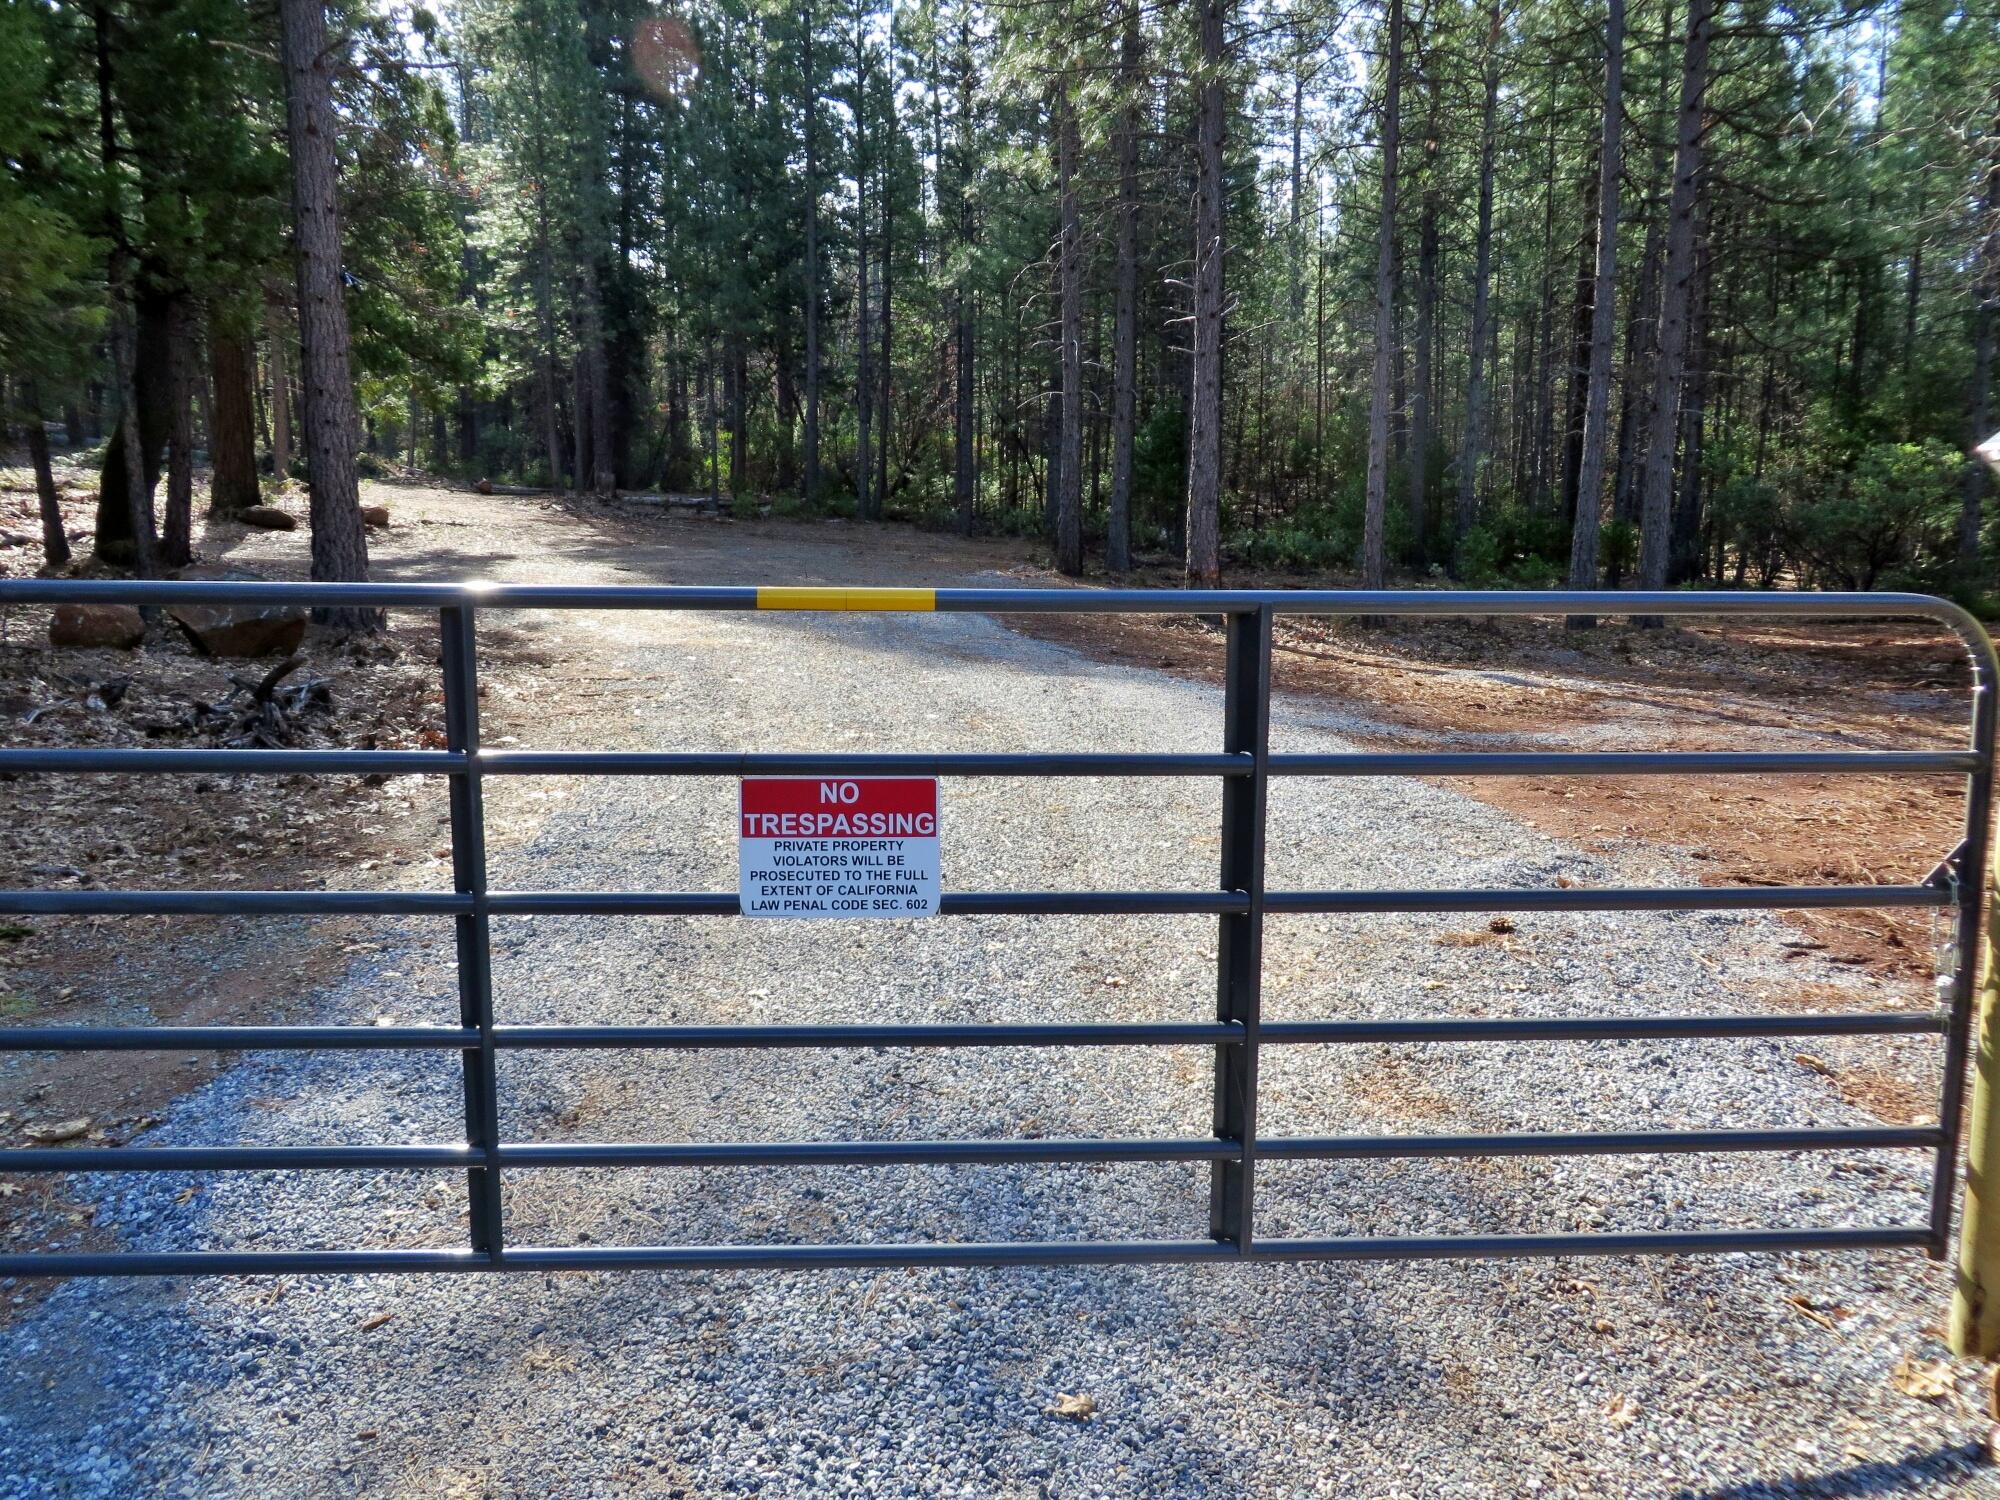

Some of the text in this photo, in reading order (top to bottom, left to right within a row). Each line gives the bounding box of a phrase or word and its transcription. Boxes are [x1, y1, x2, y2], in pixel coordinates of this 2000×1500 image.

[820, 782, 859, 804] NO
[744, 813, 934, 835] TRESPASSING
[774, 841, 904, 851] PRIVATE PROPERTY
[773, 856, 905, 866] VIOLATORS WILL BE
[750, 870, 928, 881] PROSECUTED TO THE FULL
[761, 885, 917, 895] EXTENT OF CALIFORNIA
[751, 899, 927, 910] LAW PENAL CODE SEC. 602
